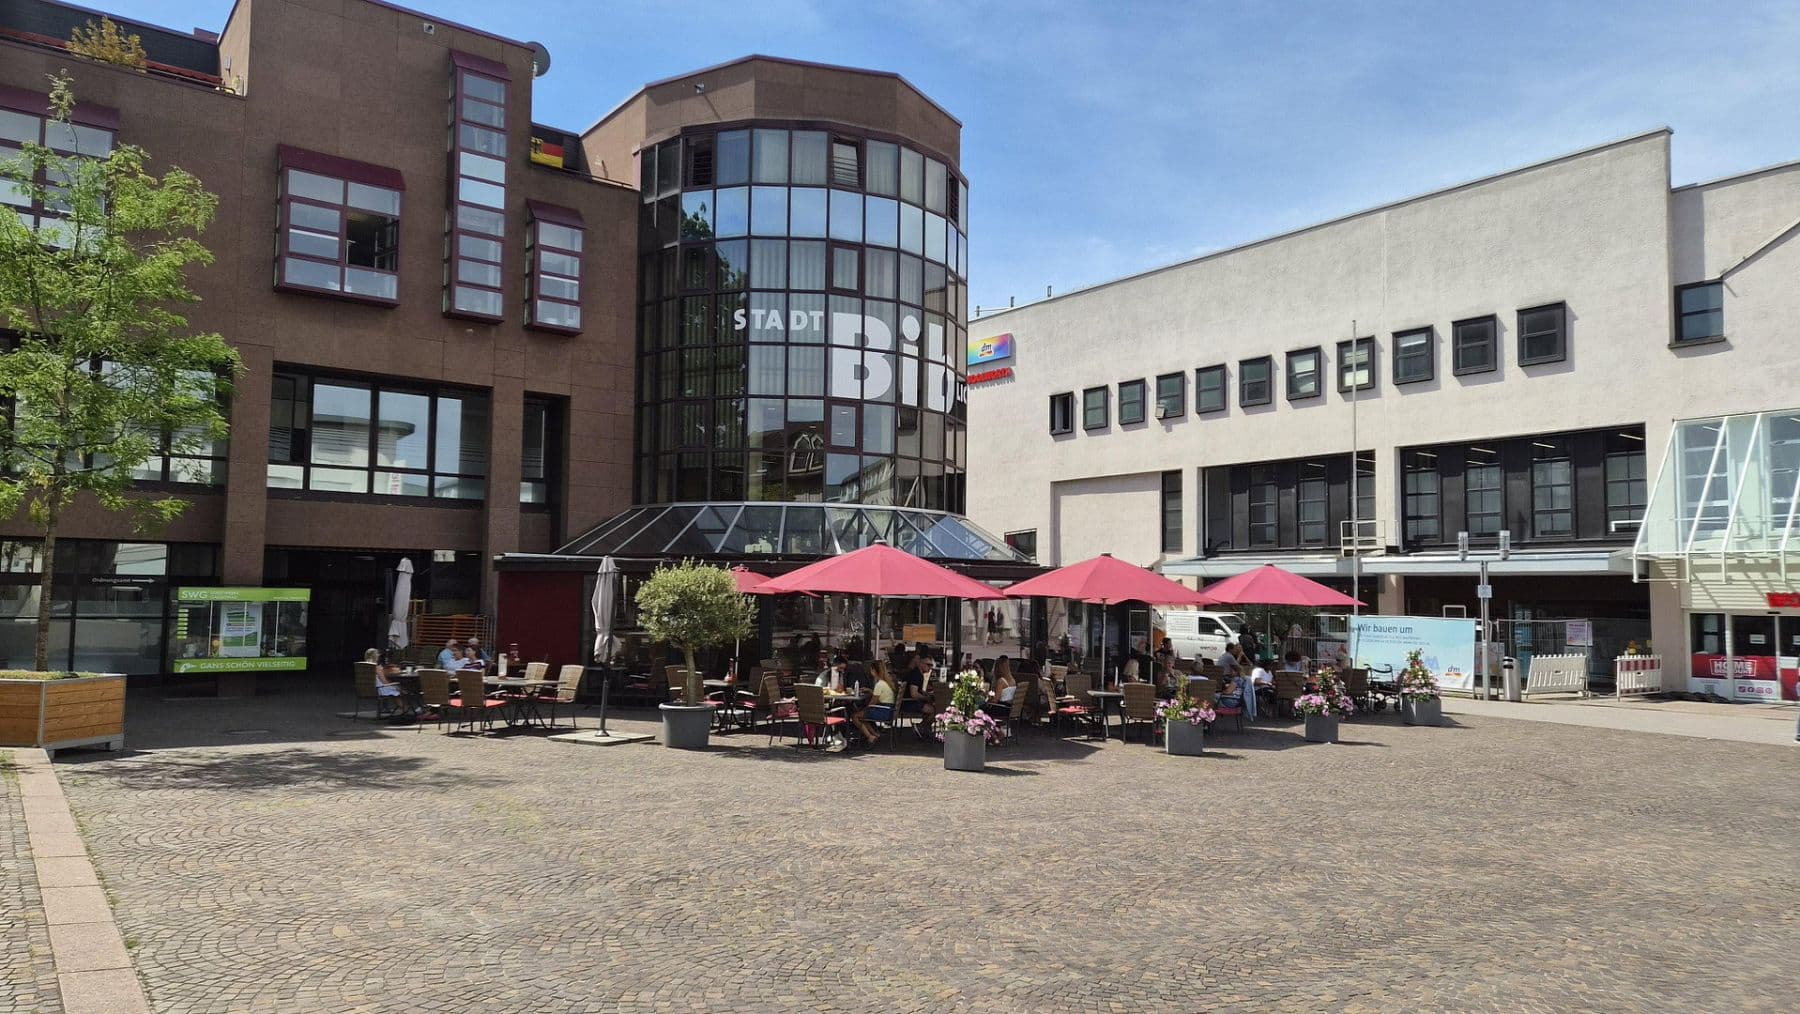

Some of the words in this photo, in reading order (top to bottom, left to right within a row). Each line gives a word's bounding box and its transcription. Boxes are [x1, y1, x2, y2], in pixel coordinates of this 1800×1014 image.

[734, 308, 824, 331] STADT
[981, 343, 992, 352] dm
[182, 591, 208, 599] SWG
[1358, 624, 1371, 632] Wir
[1373, 624, 1397, 634] bauen
[1400, 626, 1413, 634] um
[1447, 665, 1461, 673] dm
